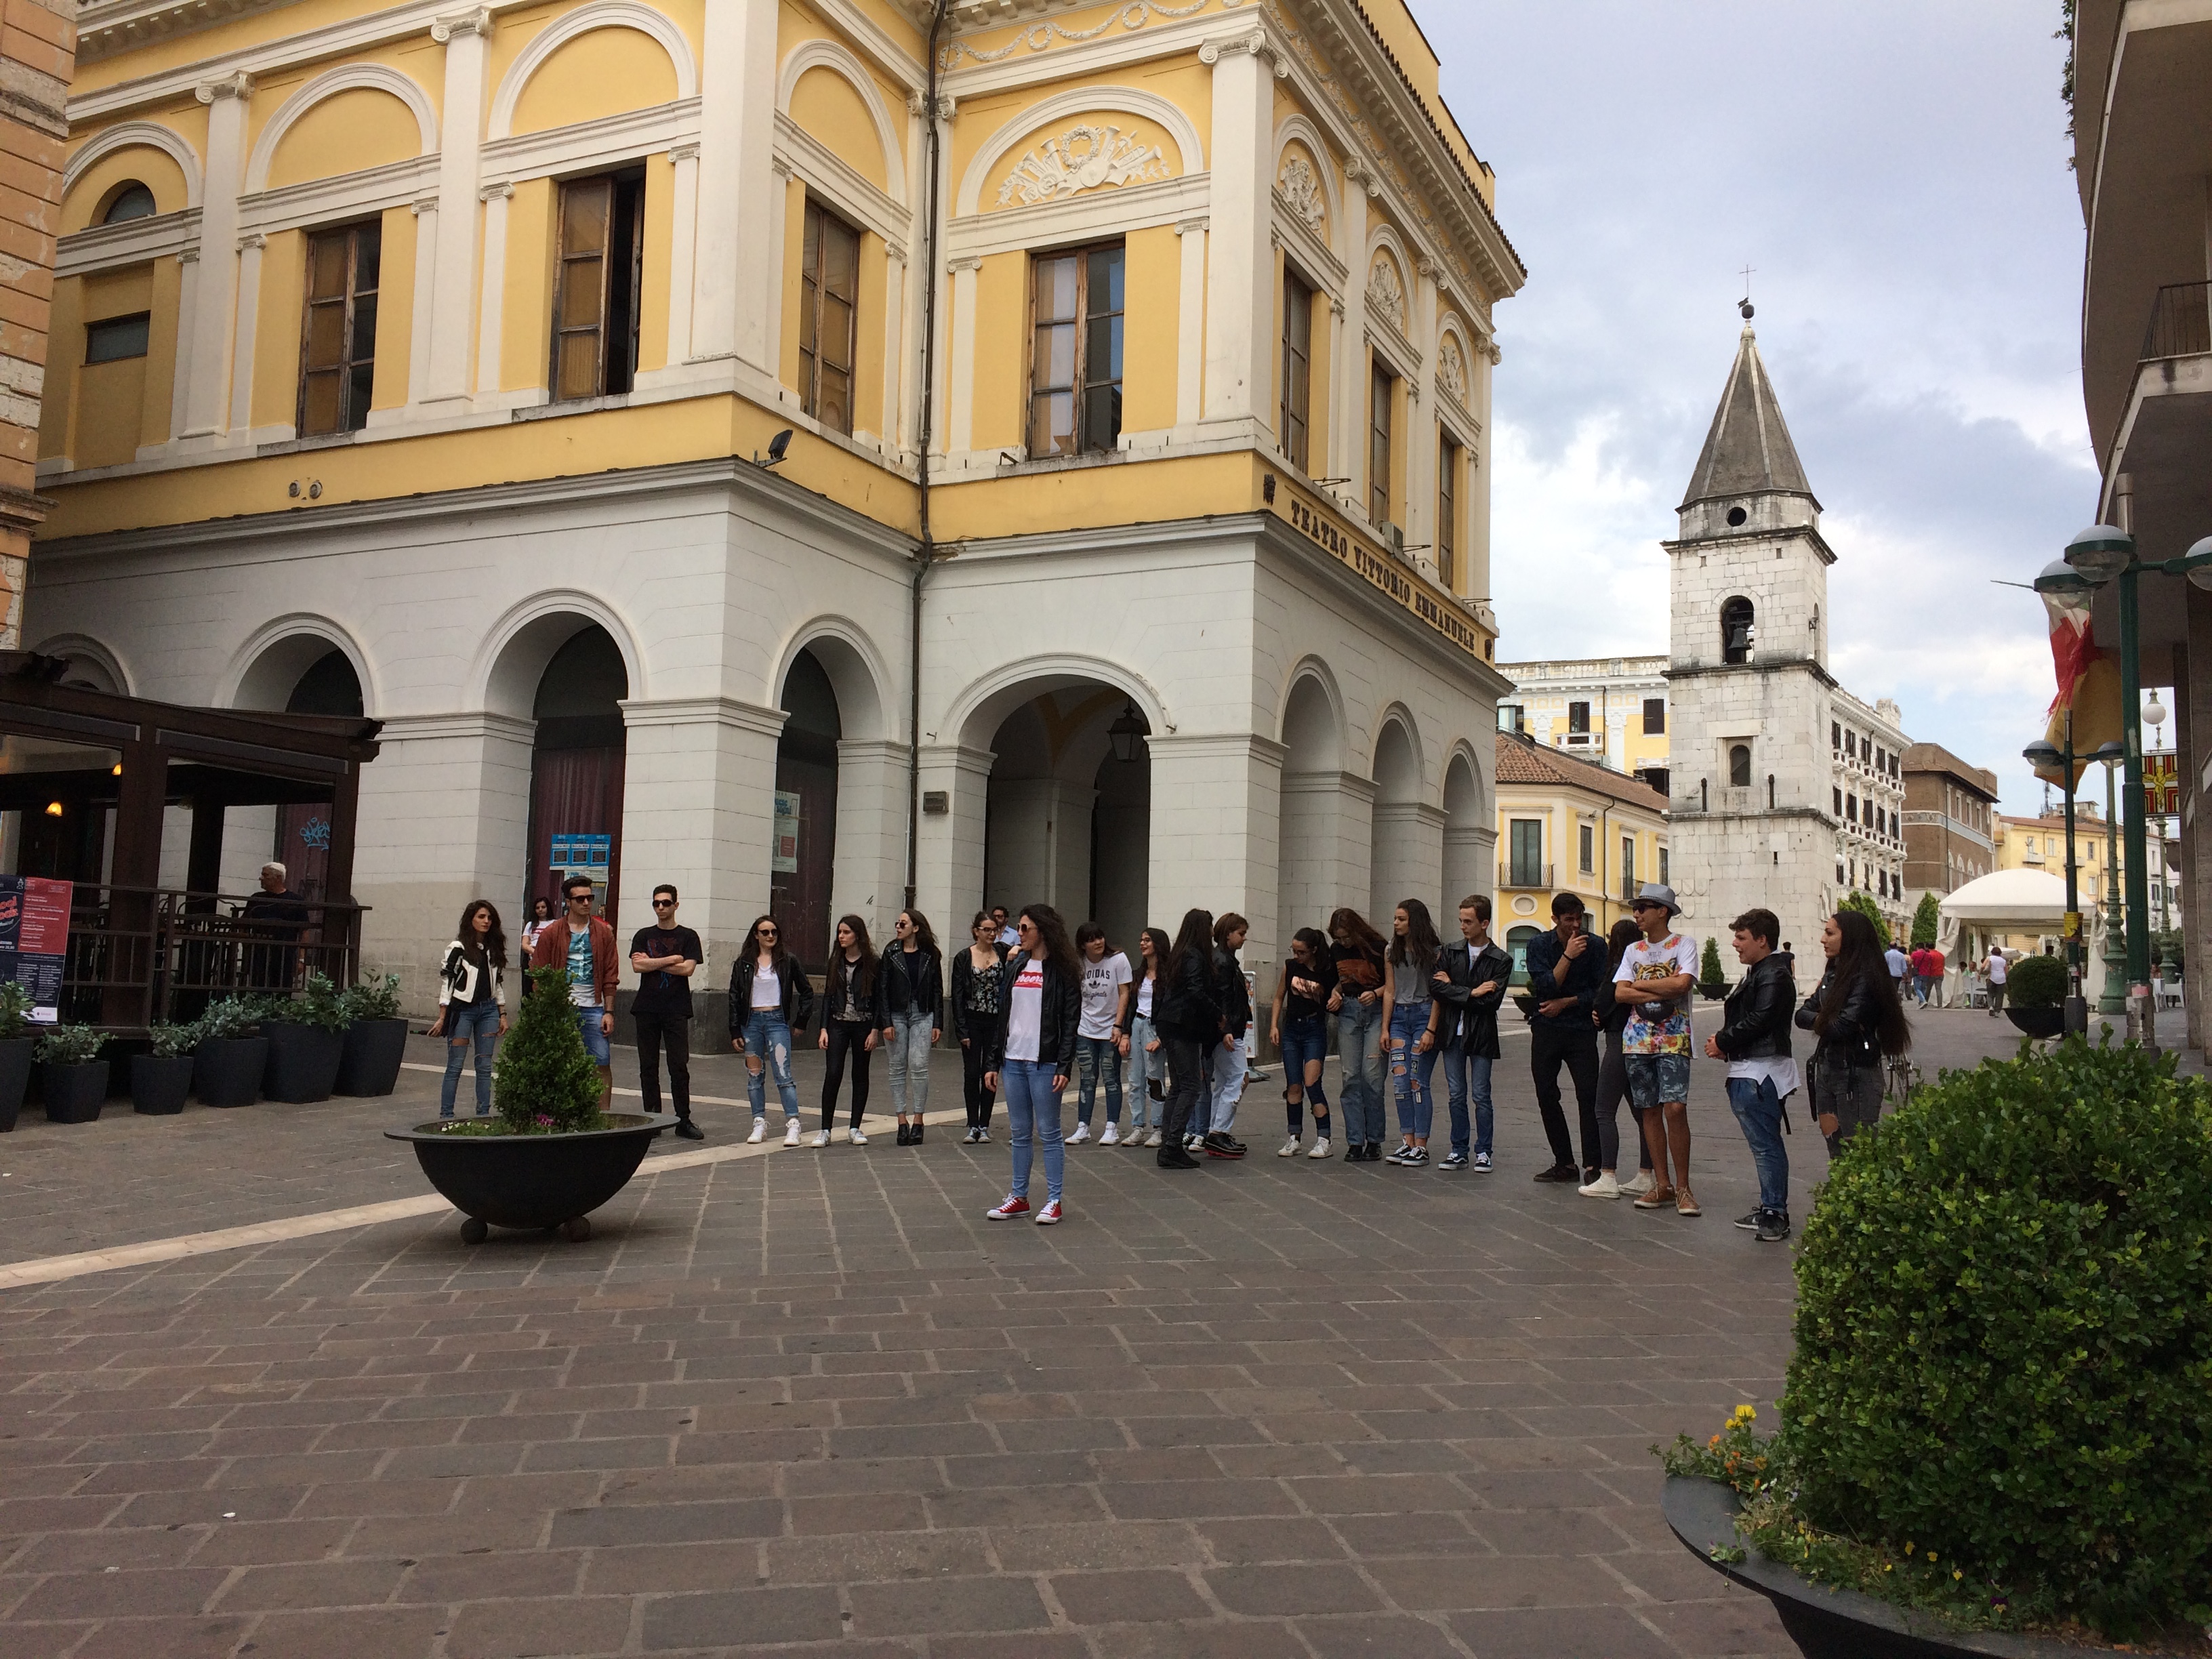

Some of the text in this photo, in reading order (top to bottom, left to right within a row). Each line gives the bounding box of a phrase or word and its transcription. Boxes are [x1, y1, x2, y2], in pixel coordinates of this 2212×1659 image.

[1291, 499, 1475, 651] TEATRO VITTORIO EMMANUELE
[1015, 973, 1044, 983] heers
[1084, 968, 1110, 980] DIDAS
